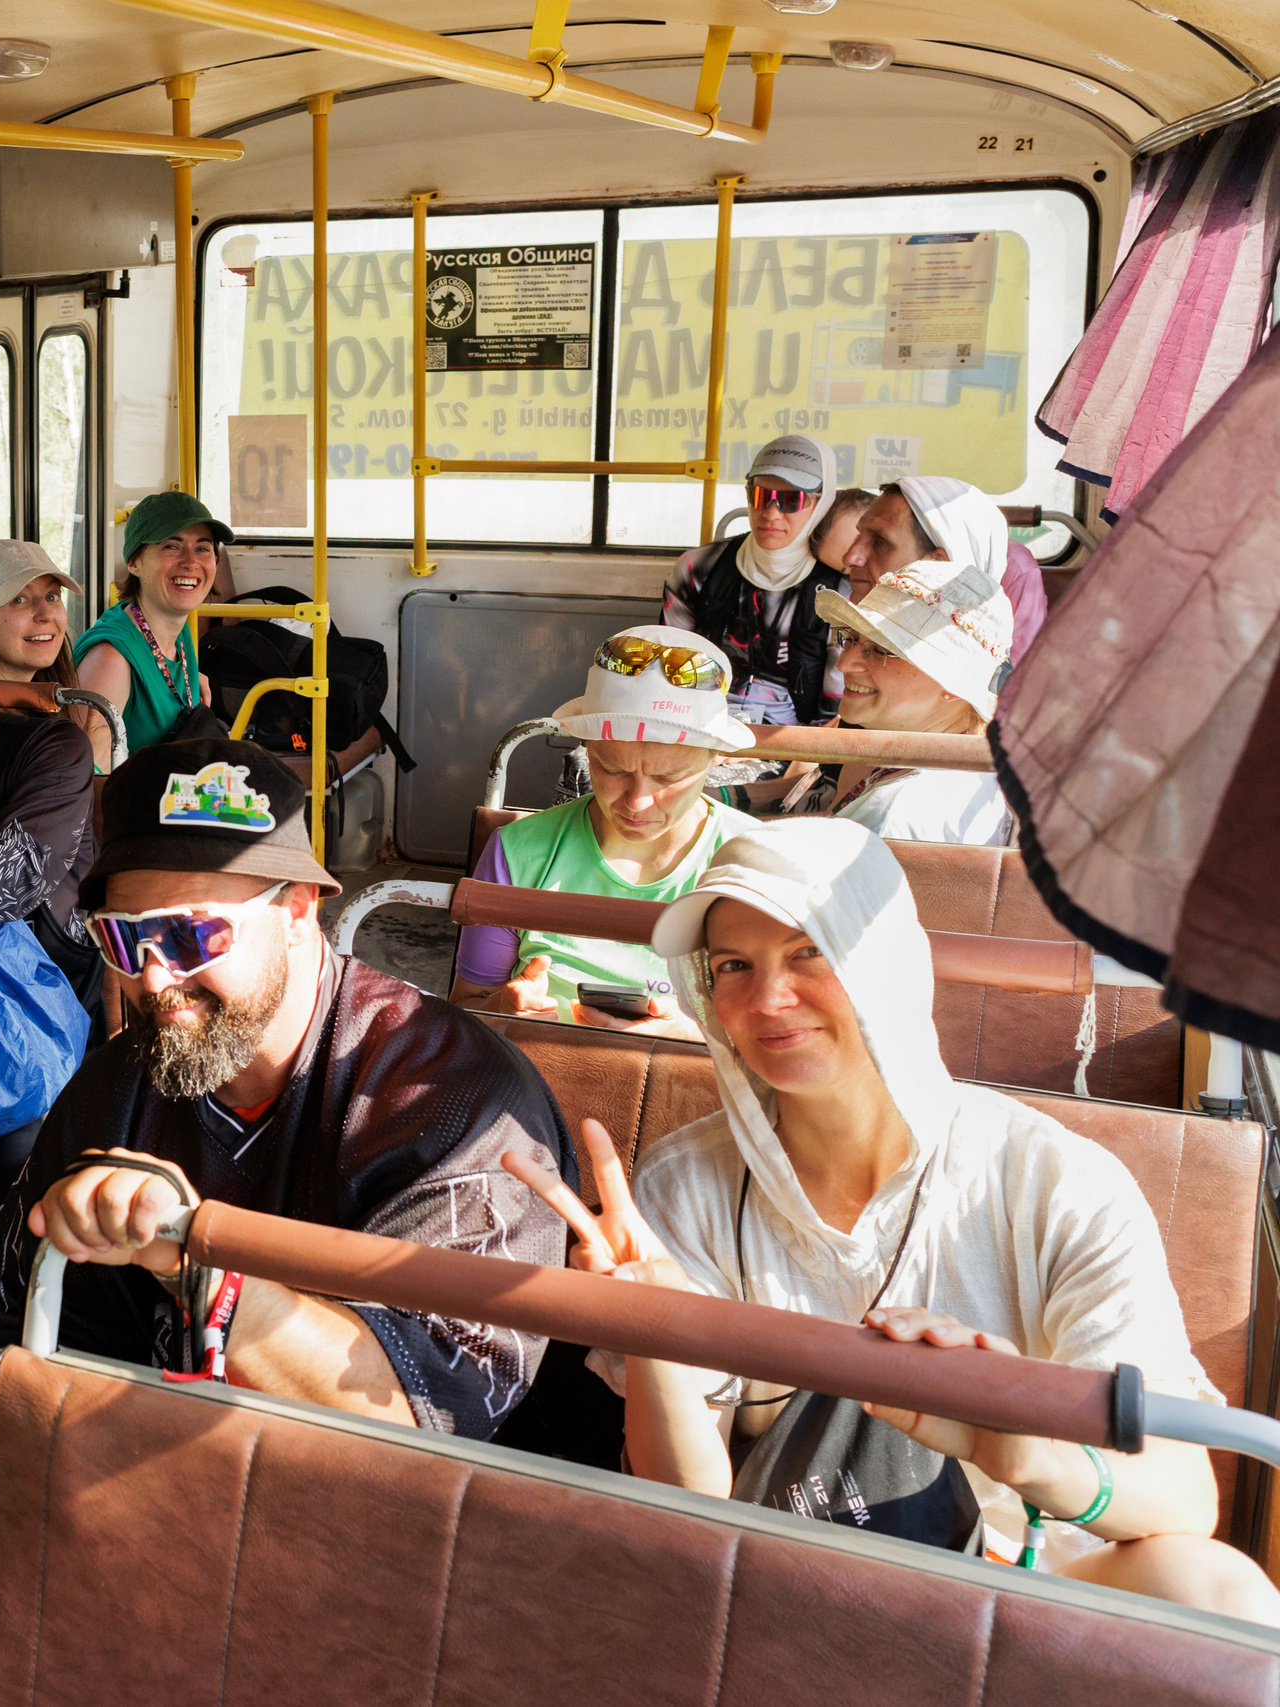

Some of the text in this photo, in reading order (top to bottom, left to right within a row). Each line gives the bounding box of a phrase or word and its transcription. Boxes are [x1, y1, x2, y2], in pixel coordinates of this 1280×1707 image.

[978, 136, 1034, 151] 22 21
[425, 247, 593, 271] Русская Община
[763, 449, 819, 464] DYNAFIT
[652, 700, 692, 715] TERMIT
